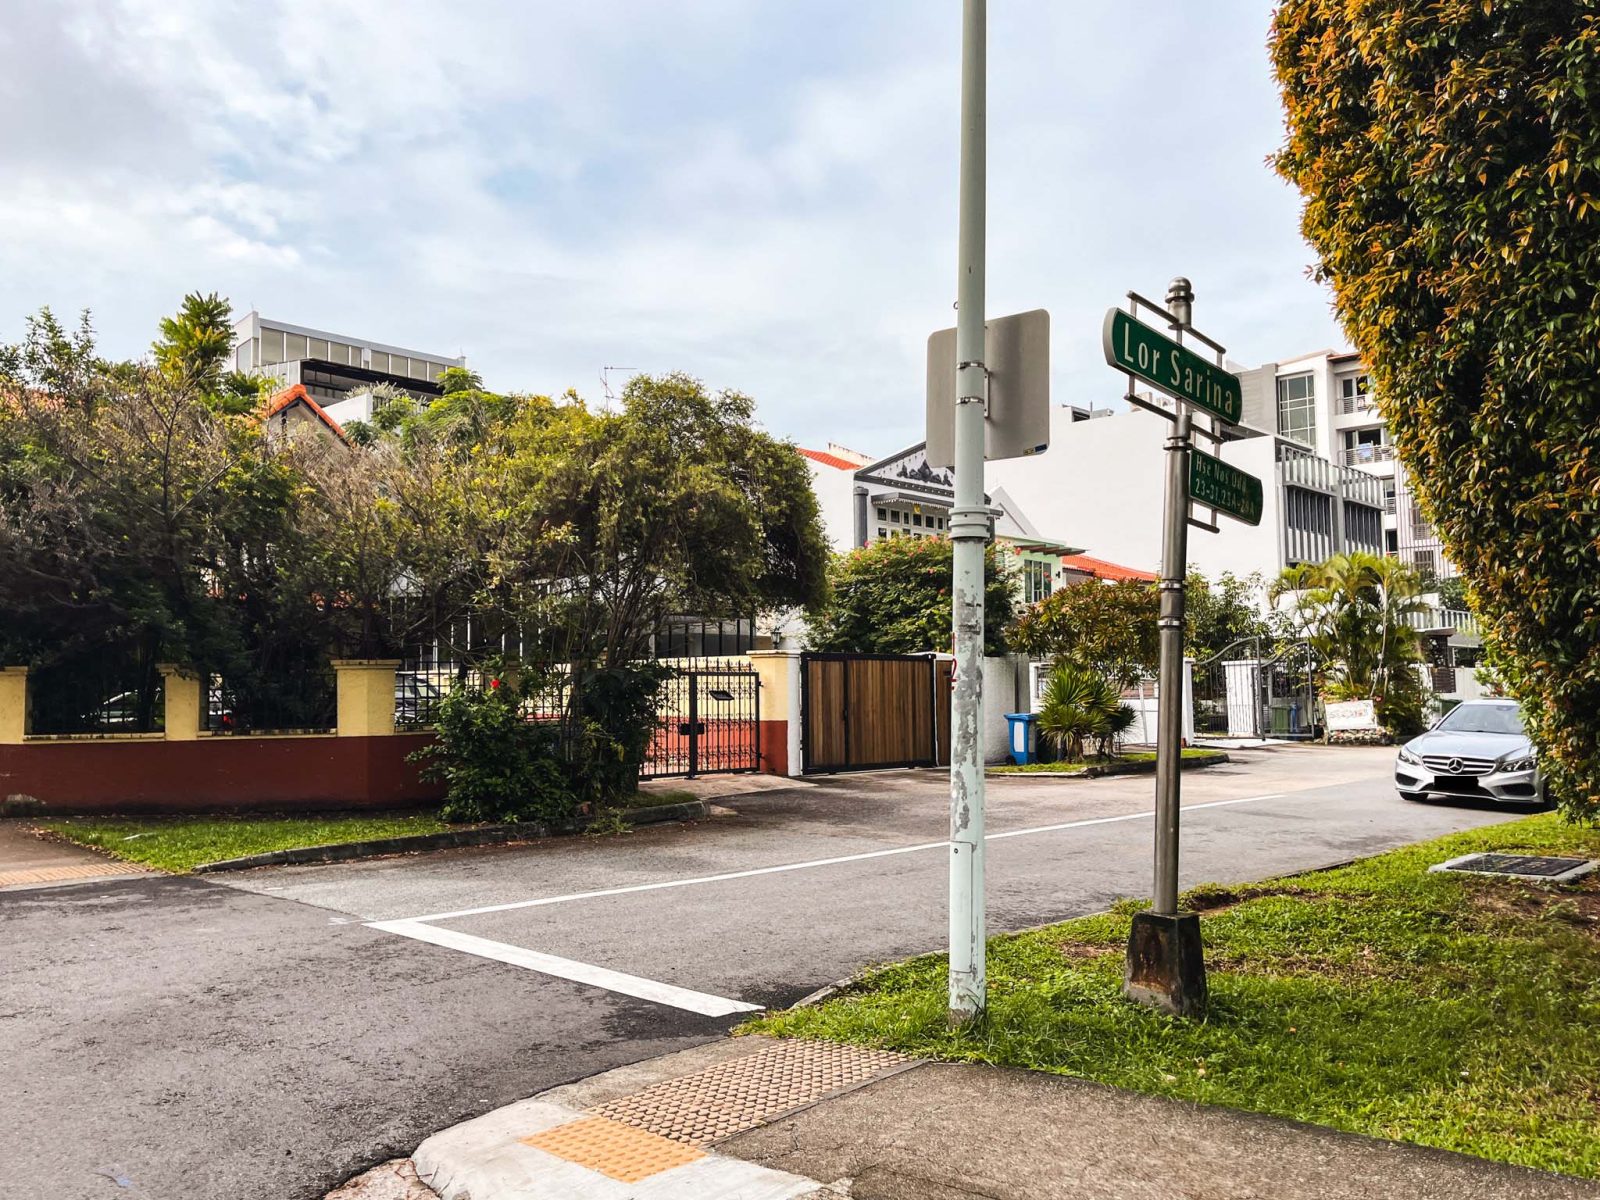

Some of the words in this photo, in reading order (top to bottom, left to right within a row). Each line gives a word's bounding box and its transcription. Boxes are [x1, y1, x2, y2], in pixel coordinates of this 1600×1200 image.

[1124, 322, 1160, 375] Lor
[1170, 349, 1233, 414] Sarina
[1196, 454, 1211, 477] Hse
[1214, 463, 1228, 485] Nos
